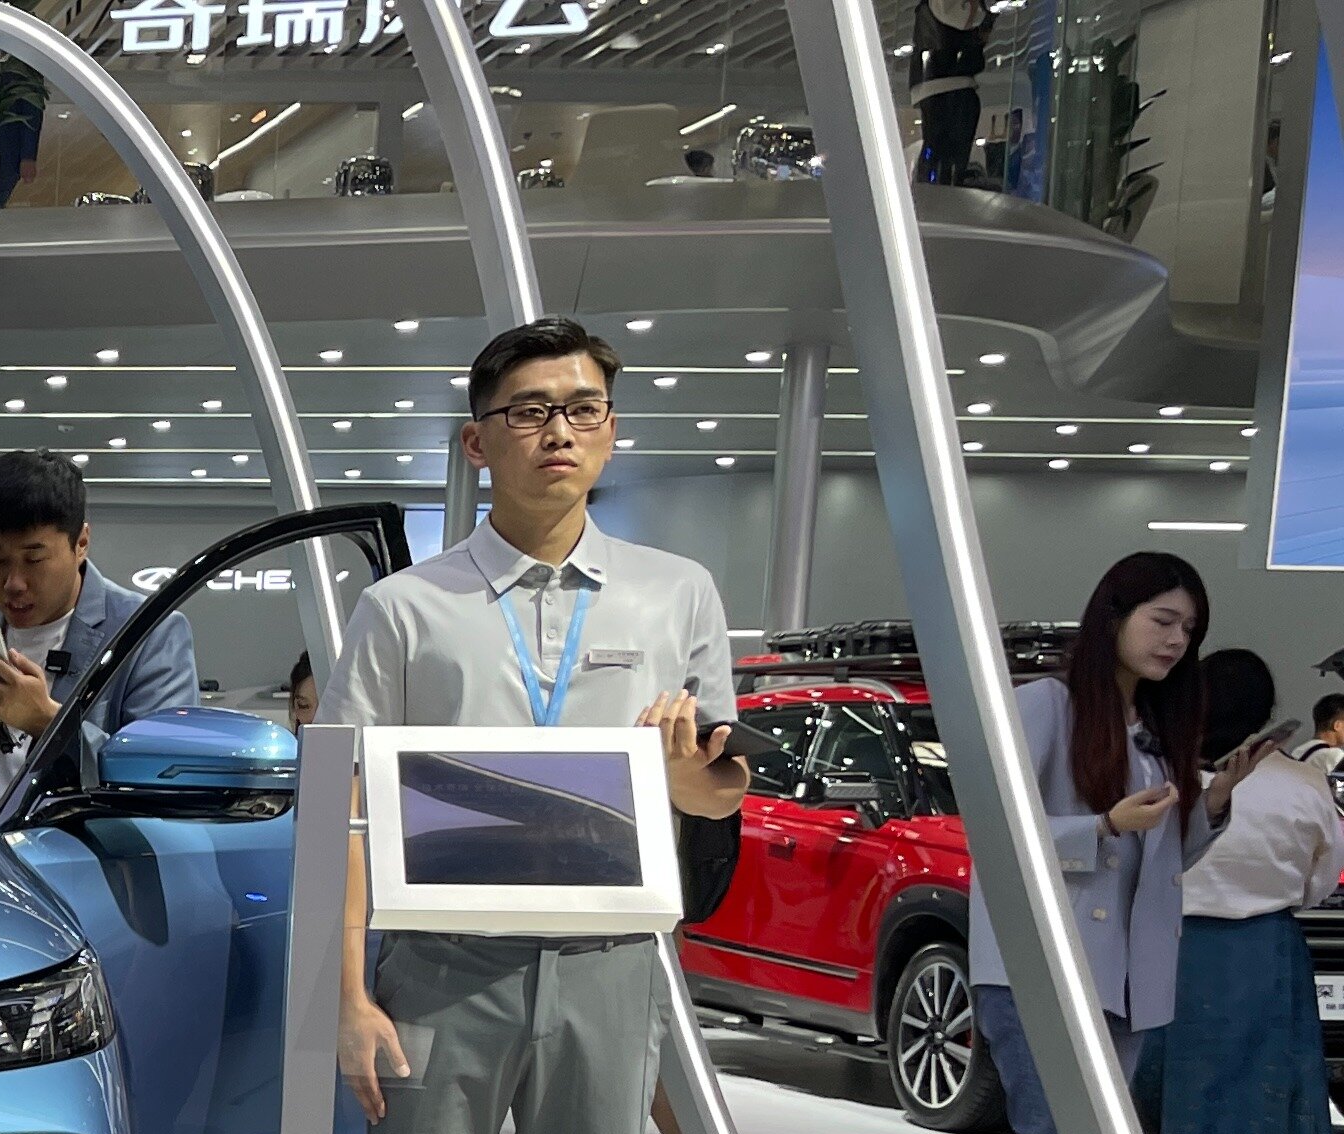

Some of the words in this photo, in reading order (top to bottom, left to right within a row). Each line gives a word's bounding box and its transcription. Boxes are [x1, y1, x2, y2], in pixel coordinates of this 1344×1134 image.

[110, 0, 589, 53] 奇瑞云
[206, 568, 350, 591] CHE
